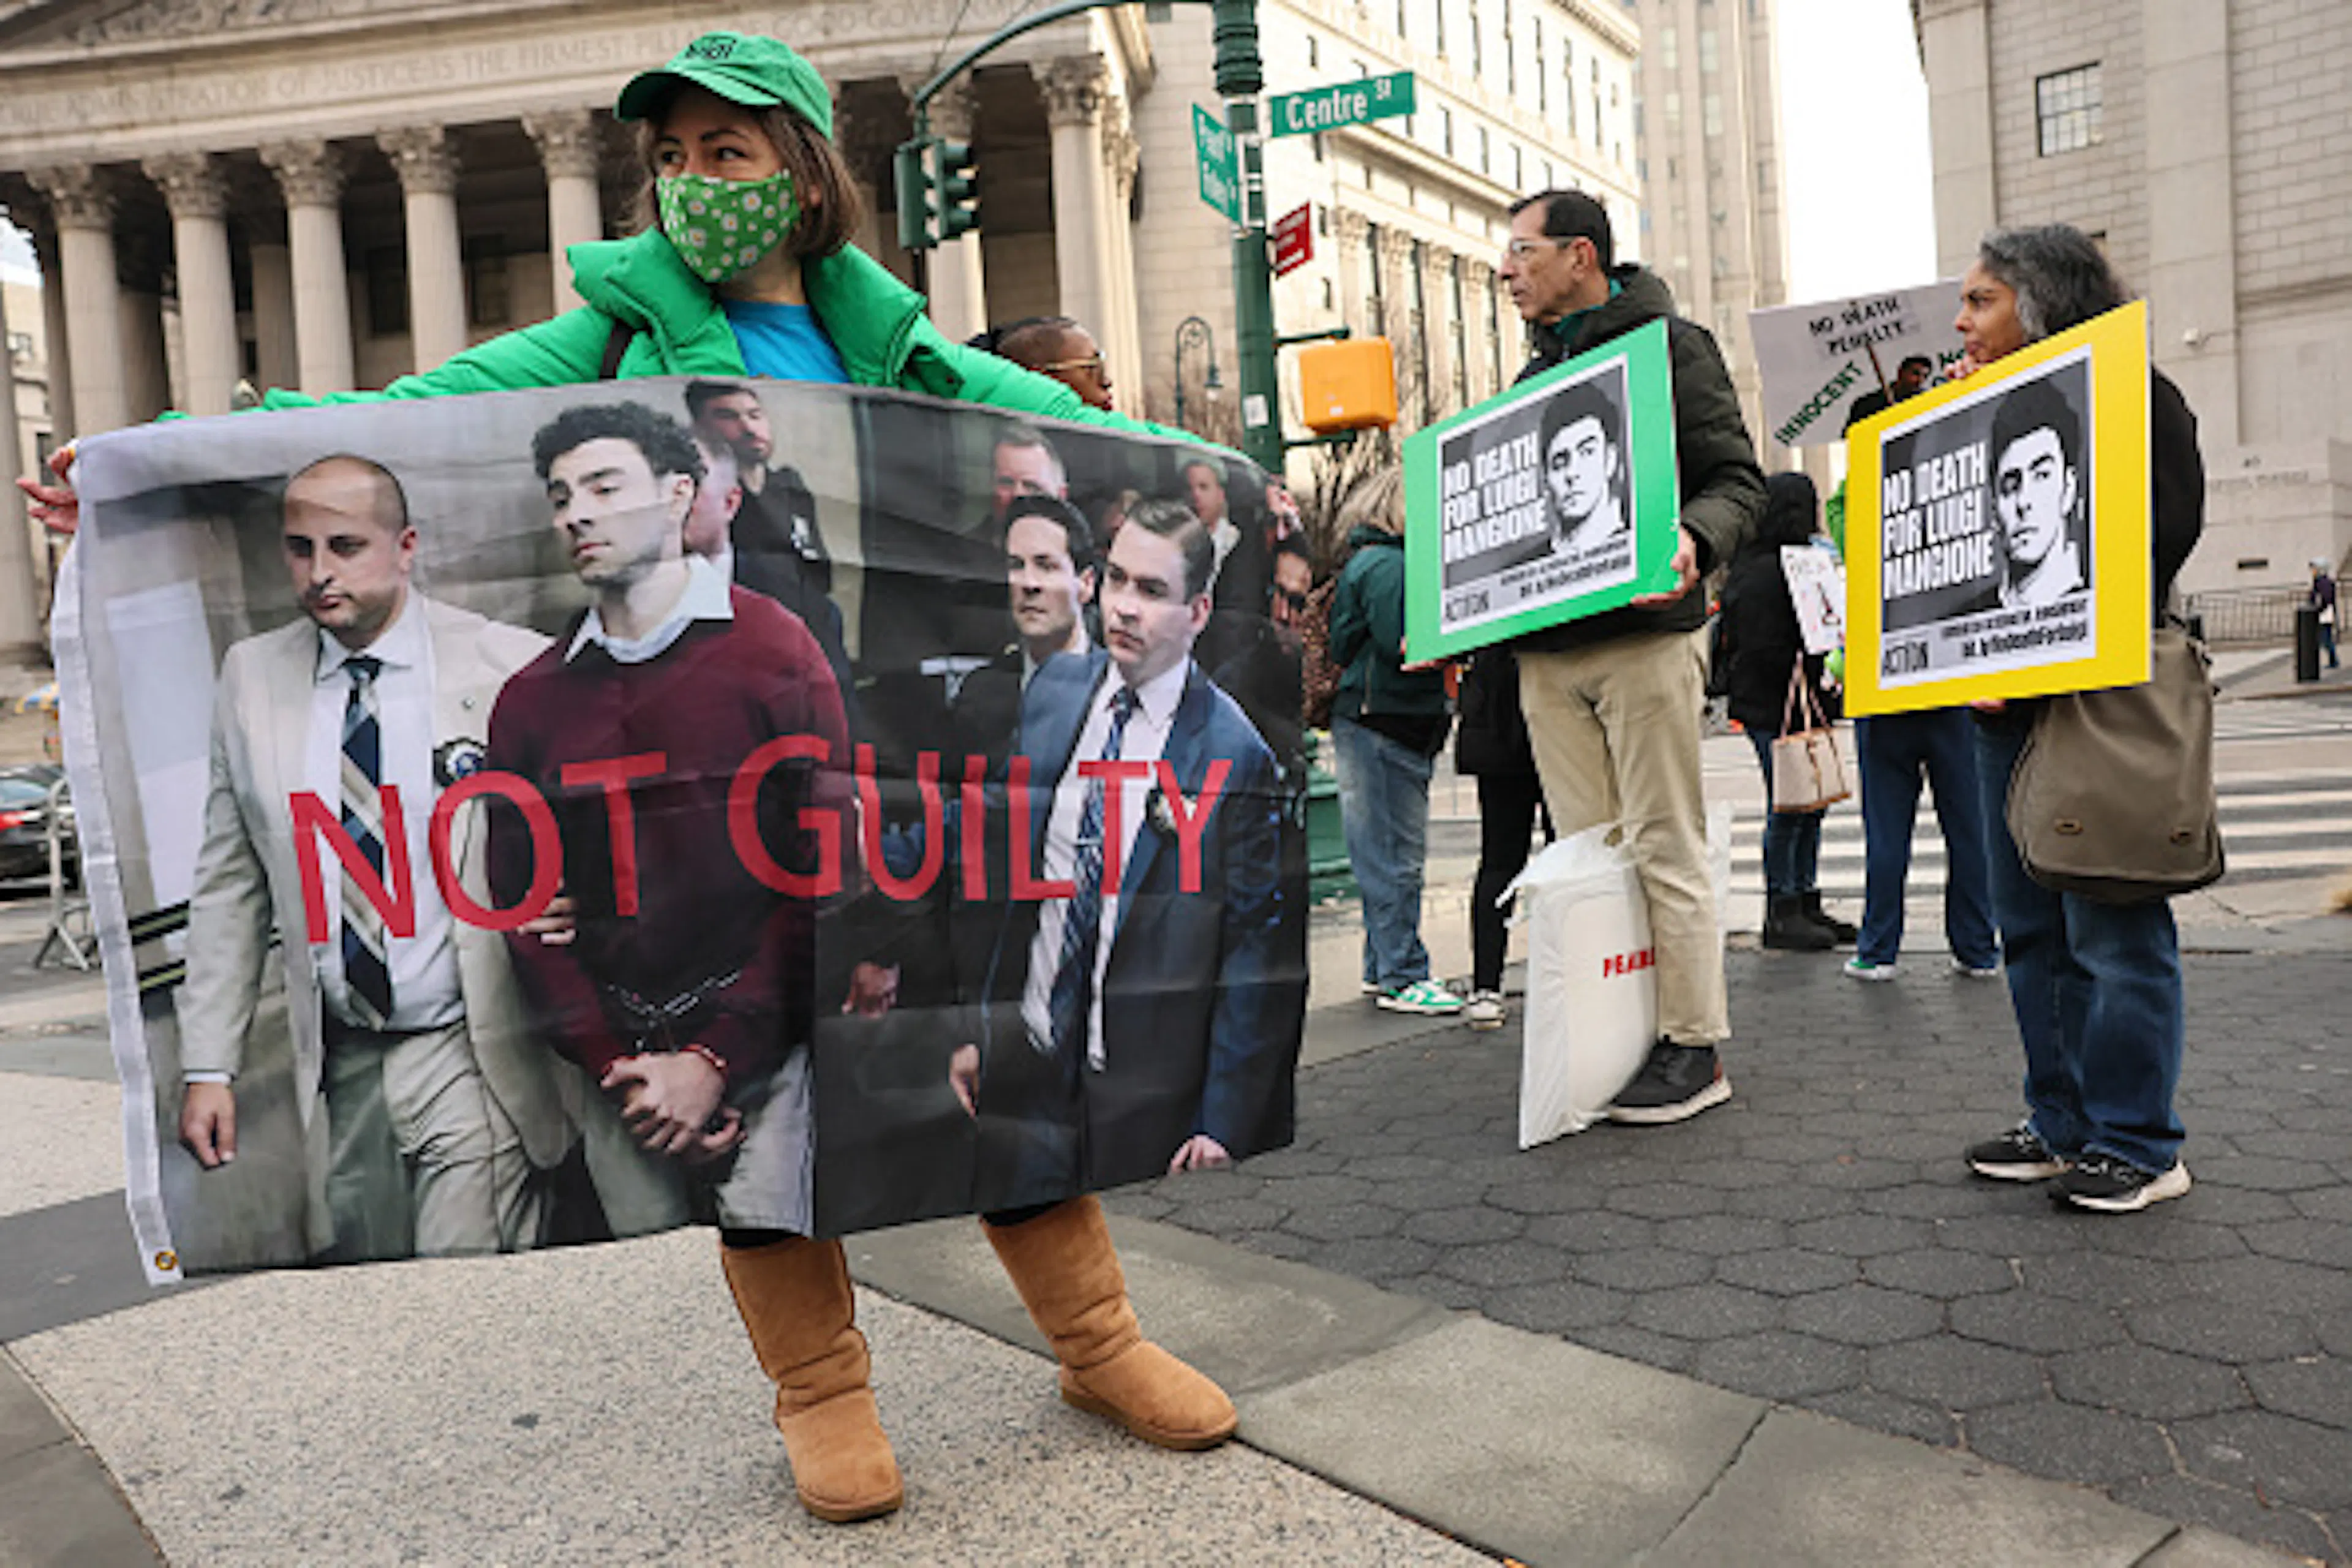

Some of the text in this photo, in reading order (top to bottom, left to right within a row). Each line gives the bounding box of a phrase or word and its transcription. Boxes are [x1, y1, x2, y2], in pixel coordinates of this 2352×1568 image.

[277, 69, 306, 98] OF
[323, 59, 421, 92] JUSTICE
[430, 55, 455, 81] IS
[464, 50, 511, 80] THE
[518, 34, 624, 70] FIRMEST
[1287, 89, 1368, 130] Centre
[1809, 316, 1834, 336] NO
[1444, 431, 1539, 500] NO DEATH
[1444, 466, 1538, 533] FOR LUIGI
[1884, 440, 1987, 517] NO DEATH
[1444, 498, 1549, 564] MANGIONE
[1884, 489, 1982, 559] FOR LUIGI
[1884, 530, 1996, 601] MANGIONE
[288, 733, 1234, 944] NOT GUILTY
